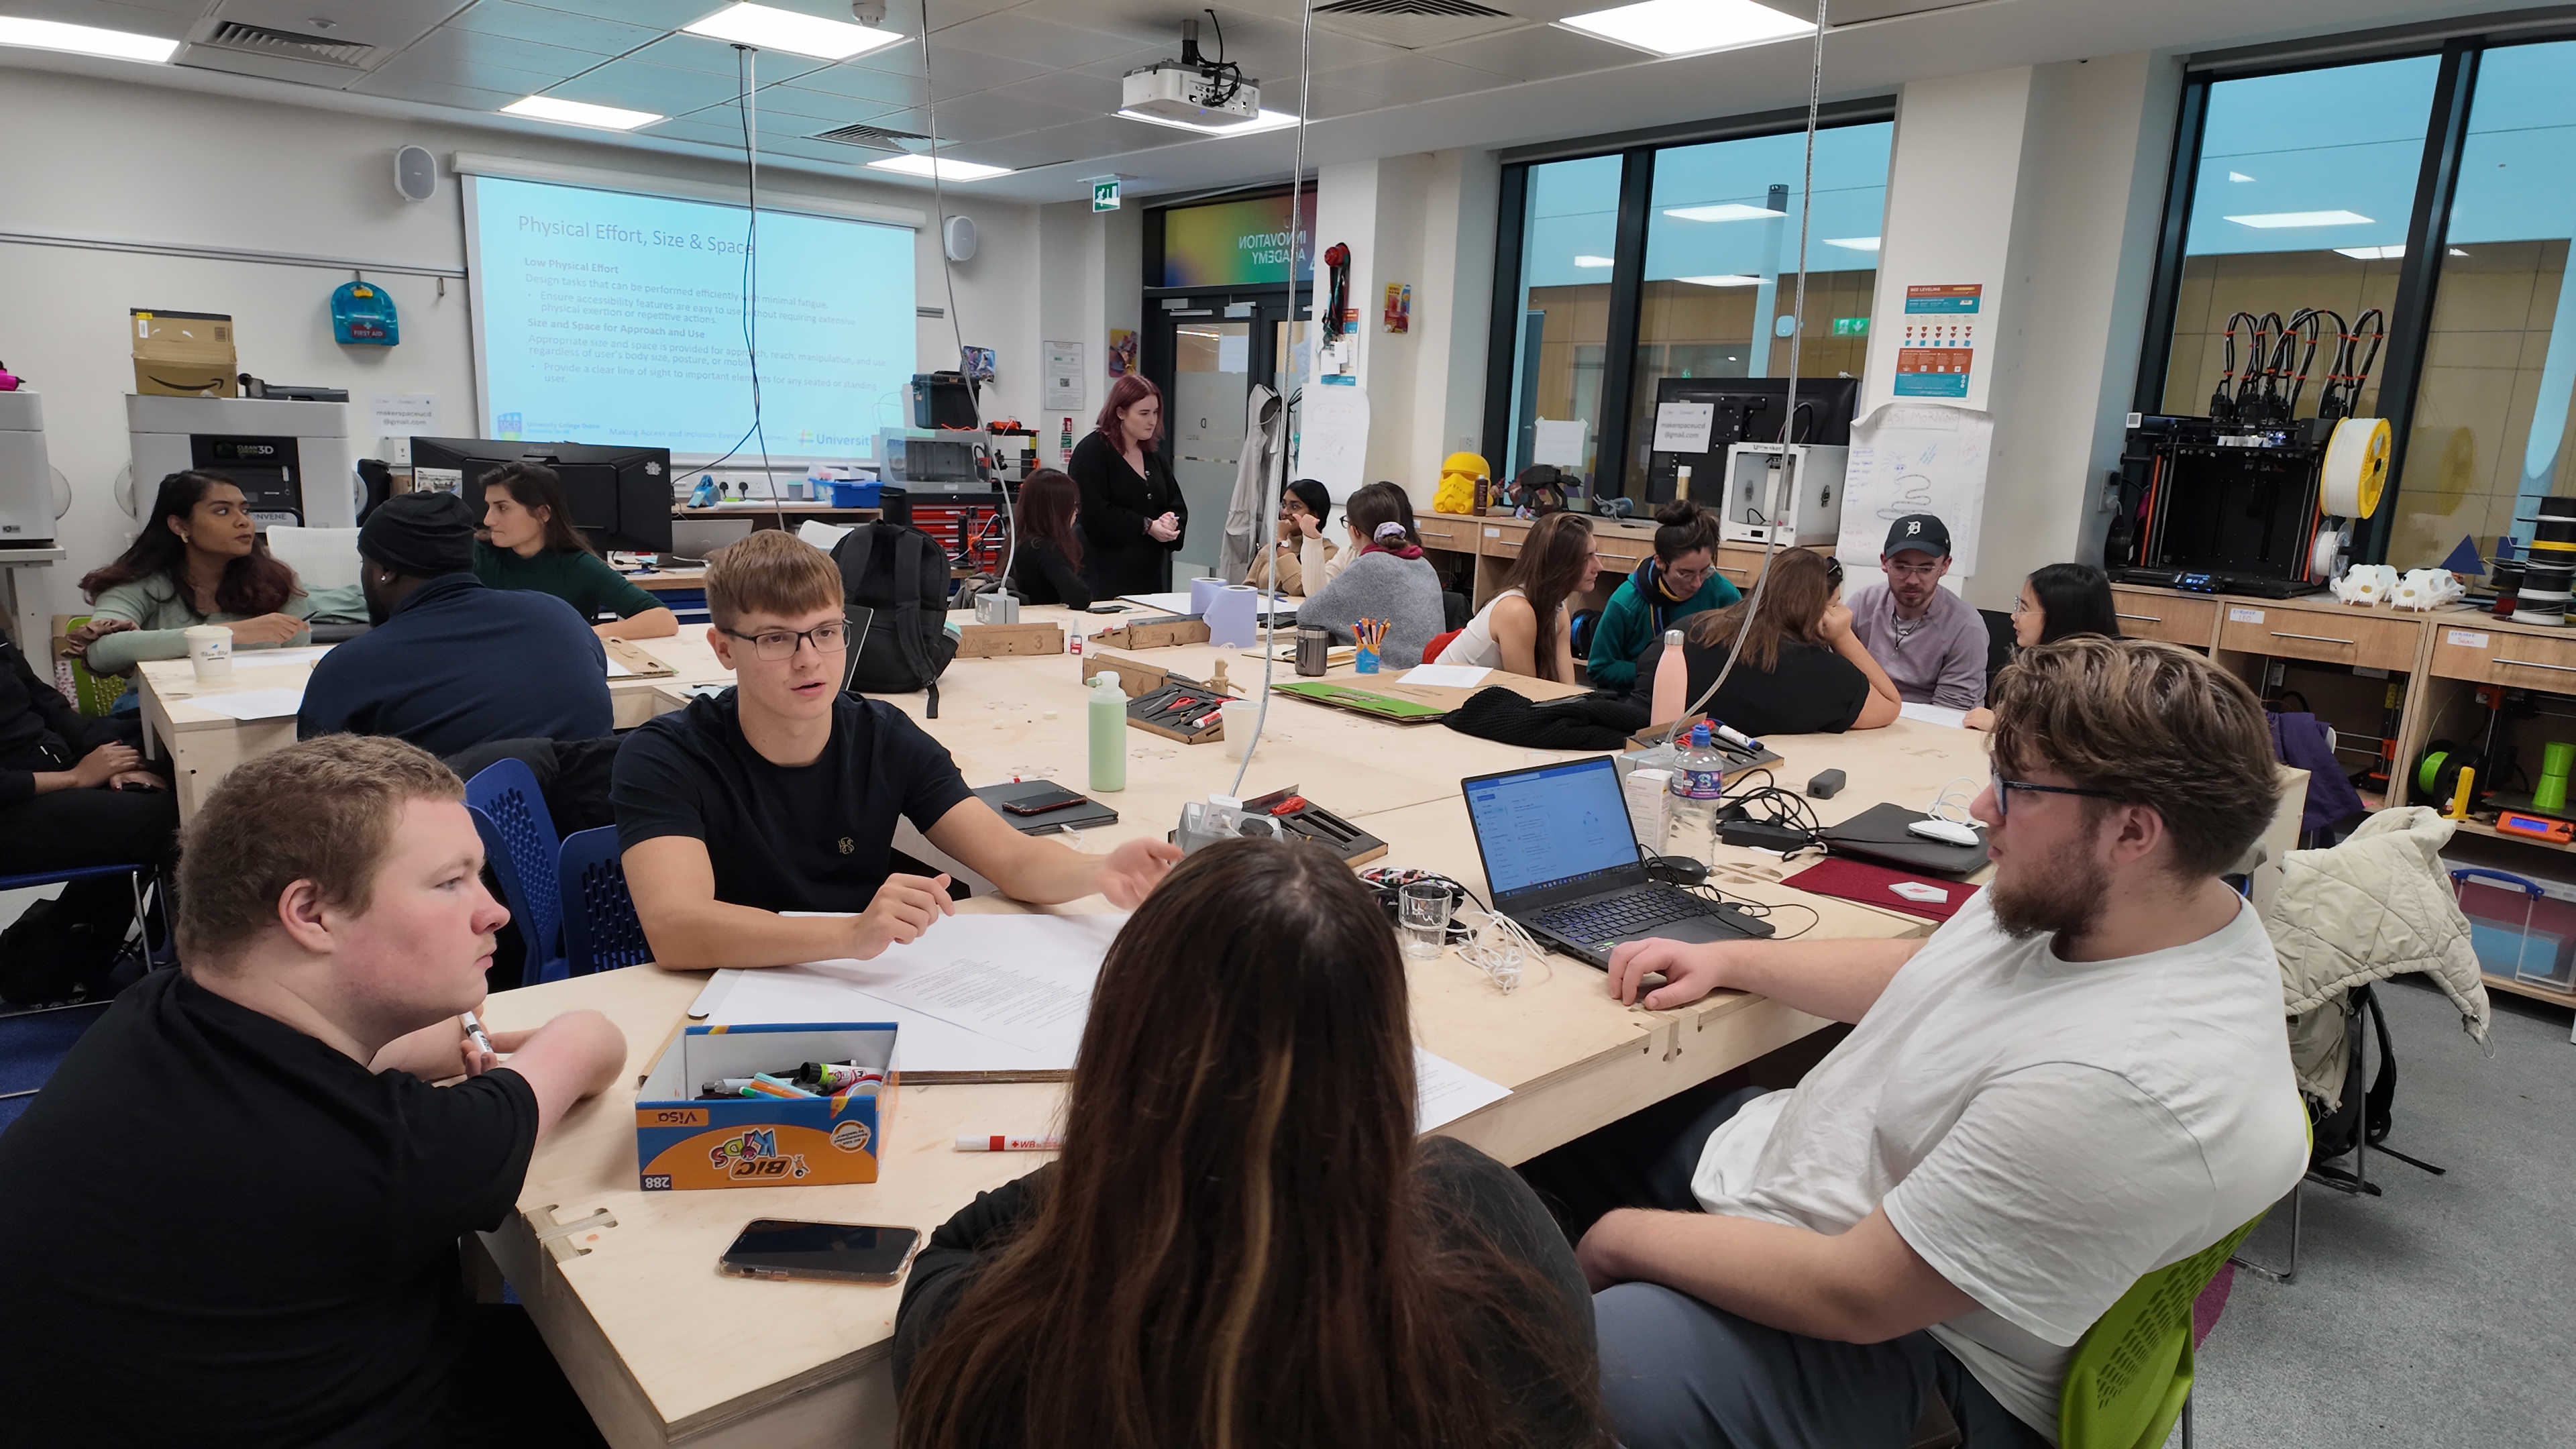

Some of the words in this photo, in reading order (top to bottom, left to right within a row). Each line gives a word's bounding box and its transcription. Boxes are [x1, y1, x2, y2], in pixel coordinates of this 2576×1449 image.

[519, 216, 589, 237] Physical
[596, 224, 647, 246] Effort,
[653, 230, 684, 248] Size
[690, 233, 703, 250] &
[708, 236, 753, 255] Space
[525, 258, 546, 267] Low
[549, 259, 589, 272] Physical
[592, 264, 619, 274] Effort
[526, 274, 559, 286] Design
[562, 276, 586, 287] tasks
[589, 279, 609, 289] that
[612, 282, 628, 290] can
[631, 282, 643, 292] be
[645, 284, 693, 298] performed
[696, 288, 738, 302] efficiently
[741, 294, 759, 302] wih
[762, 295, 796, 306] minimal
[798, 299, 828, 310] fatigue.
[541, 291, 574, 302] Ensure
[577, 295, 633, 308] accessibility
[636, 298, 674, 310] features
[676, 303, 691, 311] are
[693, 306, 712, 315] easy
[715, 306, 724, 314] to
[743, 310, 777, 319] wthout
[780, 312, 817, 323] requiring
[818, 315, 856, 326] extensive
[541, 303, 580, 314] physical
[582, 306, 621, 316] exertion
[637, 311, 680, 322] repetitive
[683, 315, 718, 324] actions.
[527, 318, 547, 327] Size
[550, 319, 569, 329] and
[572, 321, 601, 331] Space
[604, 322, 617, 332] for
[620, 325, 665, 335] Approach
[668, 328, 684, 336] and
[688, 329, 704, 338] Use
[529, 334, 588, 346] Appropriate
[590, 338, 608, 347] size
[610, 339, 629, 349] and
[631, 342, 657, 352] space
[669, 343, 708, 354] provided
[711, 346, 724, 354] for
[726, 349, 768, 358] approch,
[770, 352, 797, 361] reach,
[798, 354, 855, 365] manipulation,
[856, 358, 871, 366] and
[530, 347, 580, 357] regardless
[582, 349, 592, 357] of
[594, 350, 623, 360] user's
[625, 351, 648, 362] body
[651, 353, 669, 363] size,
[672, 355, 710, 366] posture,
[724, 358, 761, 369] mobiliy.
[543, 362, 581, 372] Provide
[592, 365, 614, 374] clear
[617, 366, 635, 376] line
[637, 367, 647, 376] of
[649, 368, 672, 378] sight
[674, 370, 683, 378] to
[686, 370, 729, 382] important
[731, 373, 771, 384] elemnts
[773, 375, 785, 384] for
[788, 378, 802, 387] any
[804, 377, 830, 387] seated
[844, 380, 876, 391] standing
[544, 376, 568, 384] user.
[1911, 411, 1958, 423] MORNING
[609, 429, 639, 437] Making
[641, 429, 665, 437] Access
[684, 431, 716, 439] Inclusion
[258, 445, 274, 455] 3D
[1189, 625, 1195, 639] 2
[1034, 635, 1043, 650] 3
[1136, 678, 1144, 695] 4
[657, 1111, 697, 1125] Visa
[645, 1177, 669, 1188] 288
